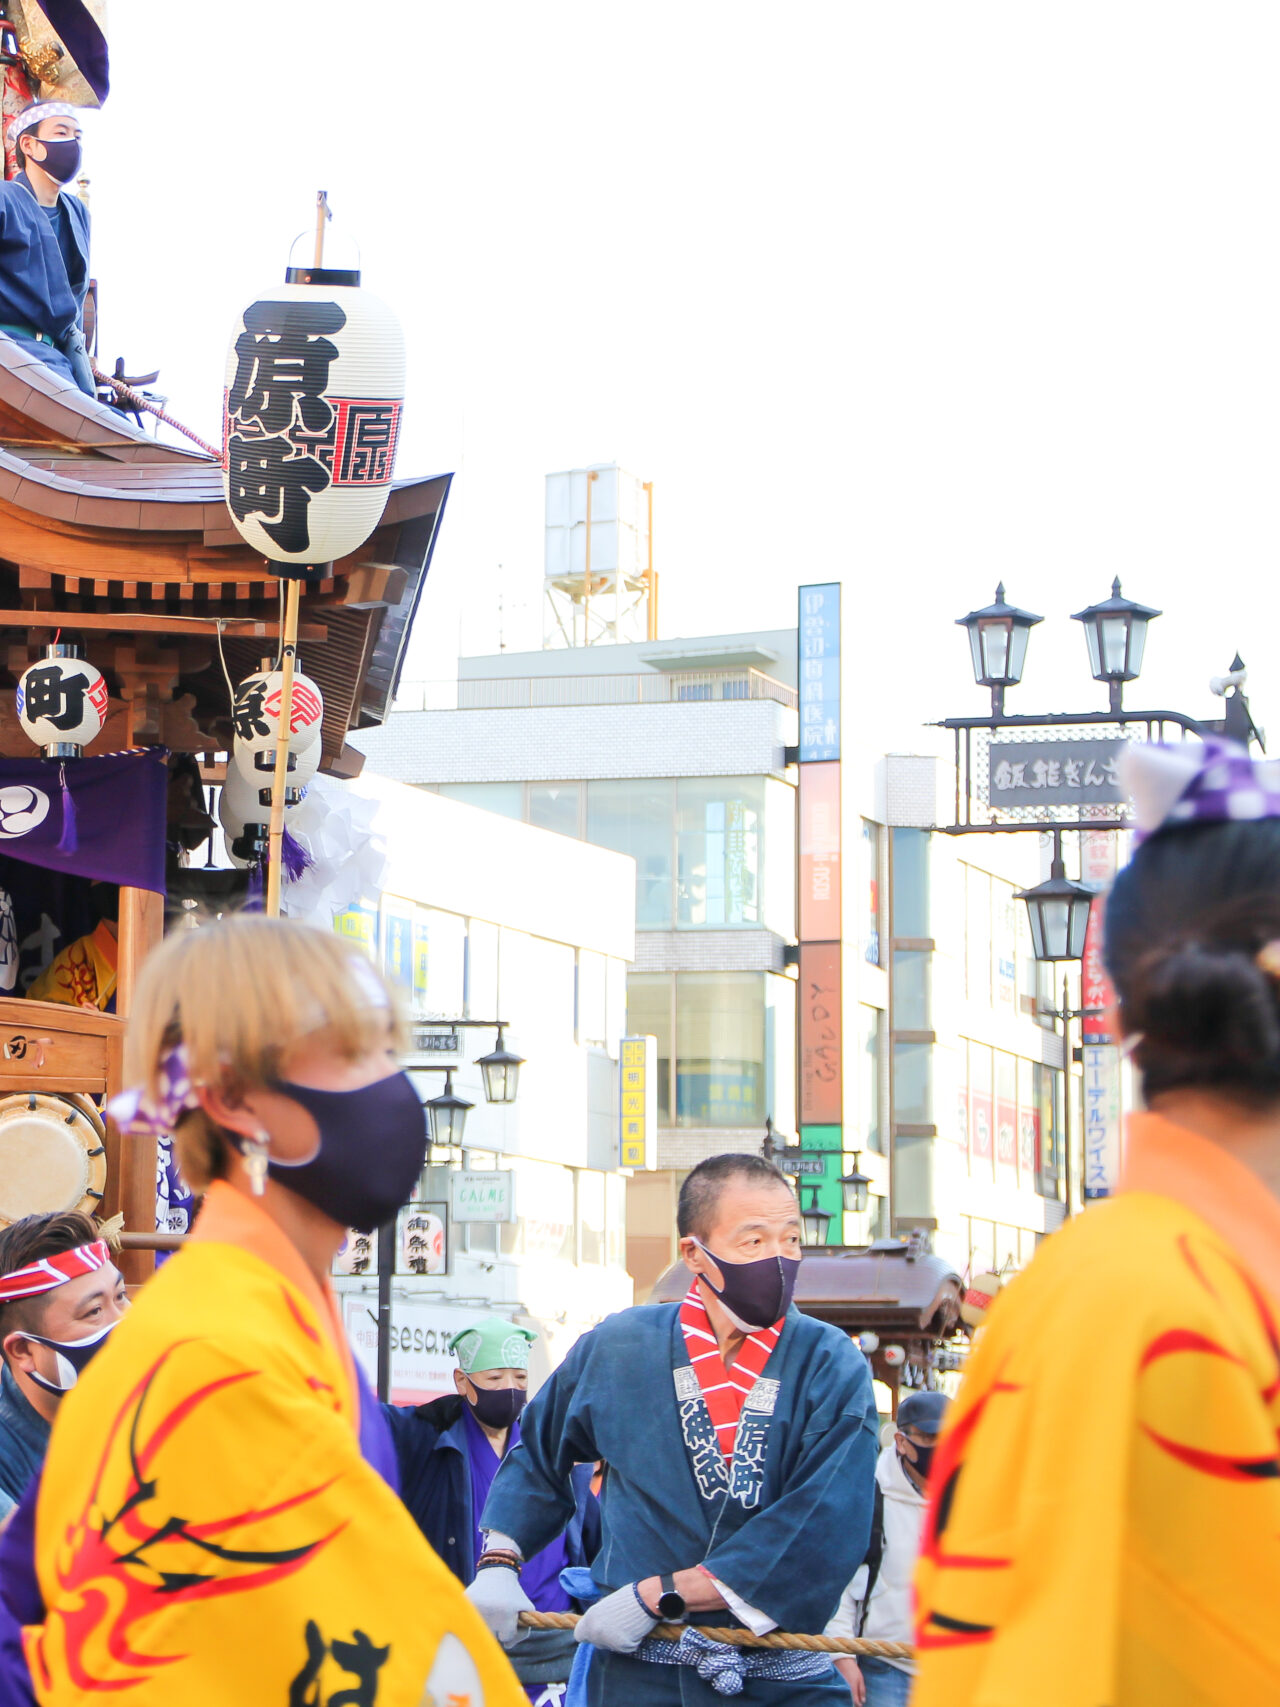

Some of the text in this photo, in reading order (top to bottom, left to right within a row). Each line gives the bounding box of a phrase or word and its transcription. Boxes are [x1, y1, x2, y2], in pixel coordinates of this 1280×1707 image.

[228, 301, 347, 553] 原町
[26, 666, 90, 731] 町
[232, 680, 270, 741] 原
[1088, 1049, 1107, 1182] エーデルワイス
[730, 1411, 775, 1509] 原町
